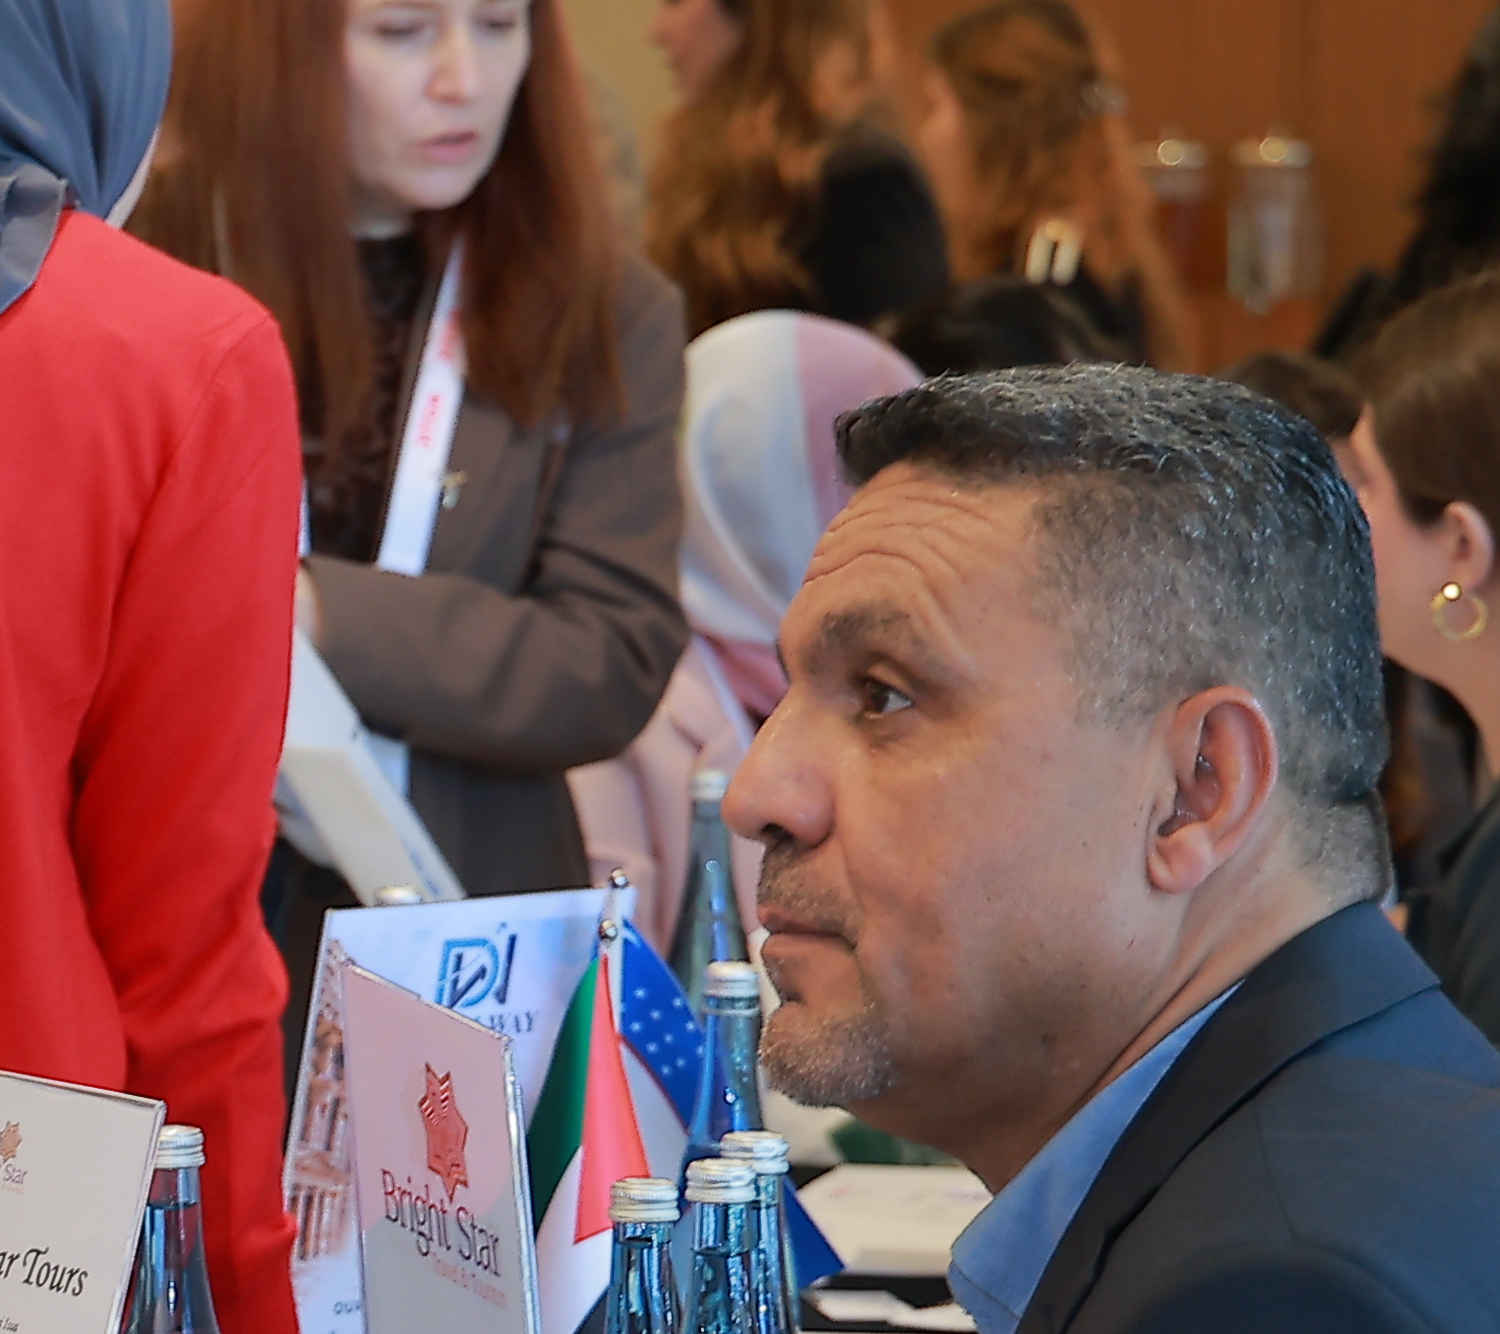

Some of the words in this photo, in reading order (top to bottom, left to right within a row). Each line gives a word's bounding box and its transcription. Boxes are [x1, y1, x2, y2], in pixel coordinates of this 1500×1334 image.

[381, 1168, 452, 1257] Bright
[457, 1206, 501, 1277] Star
[22, 1246, 89, 1297] Tours
